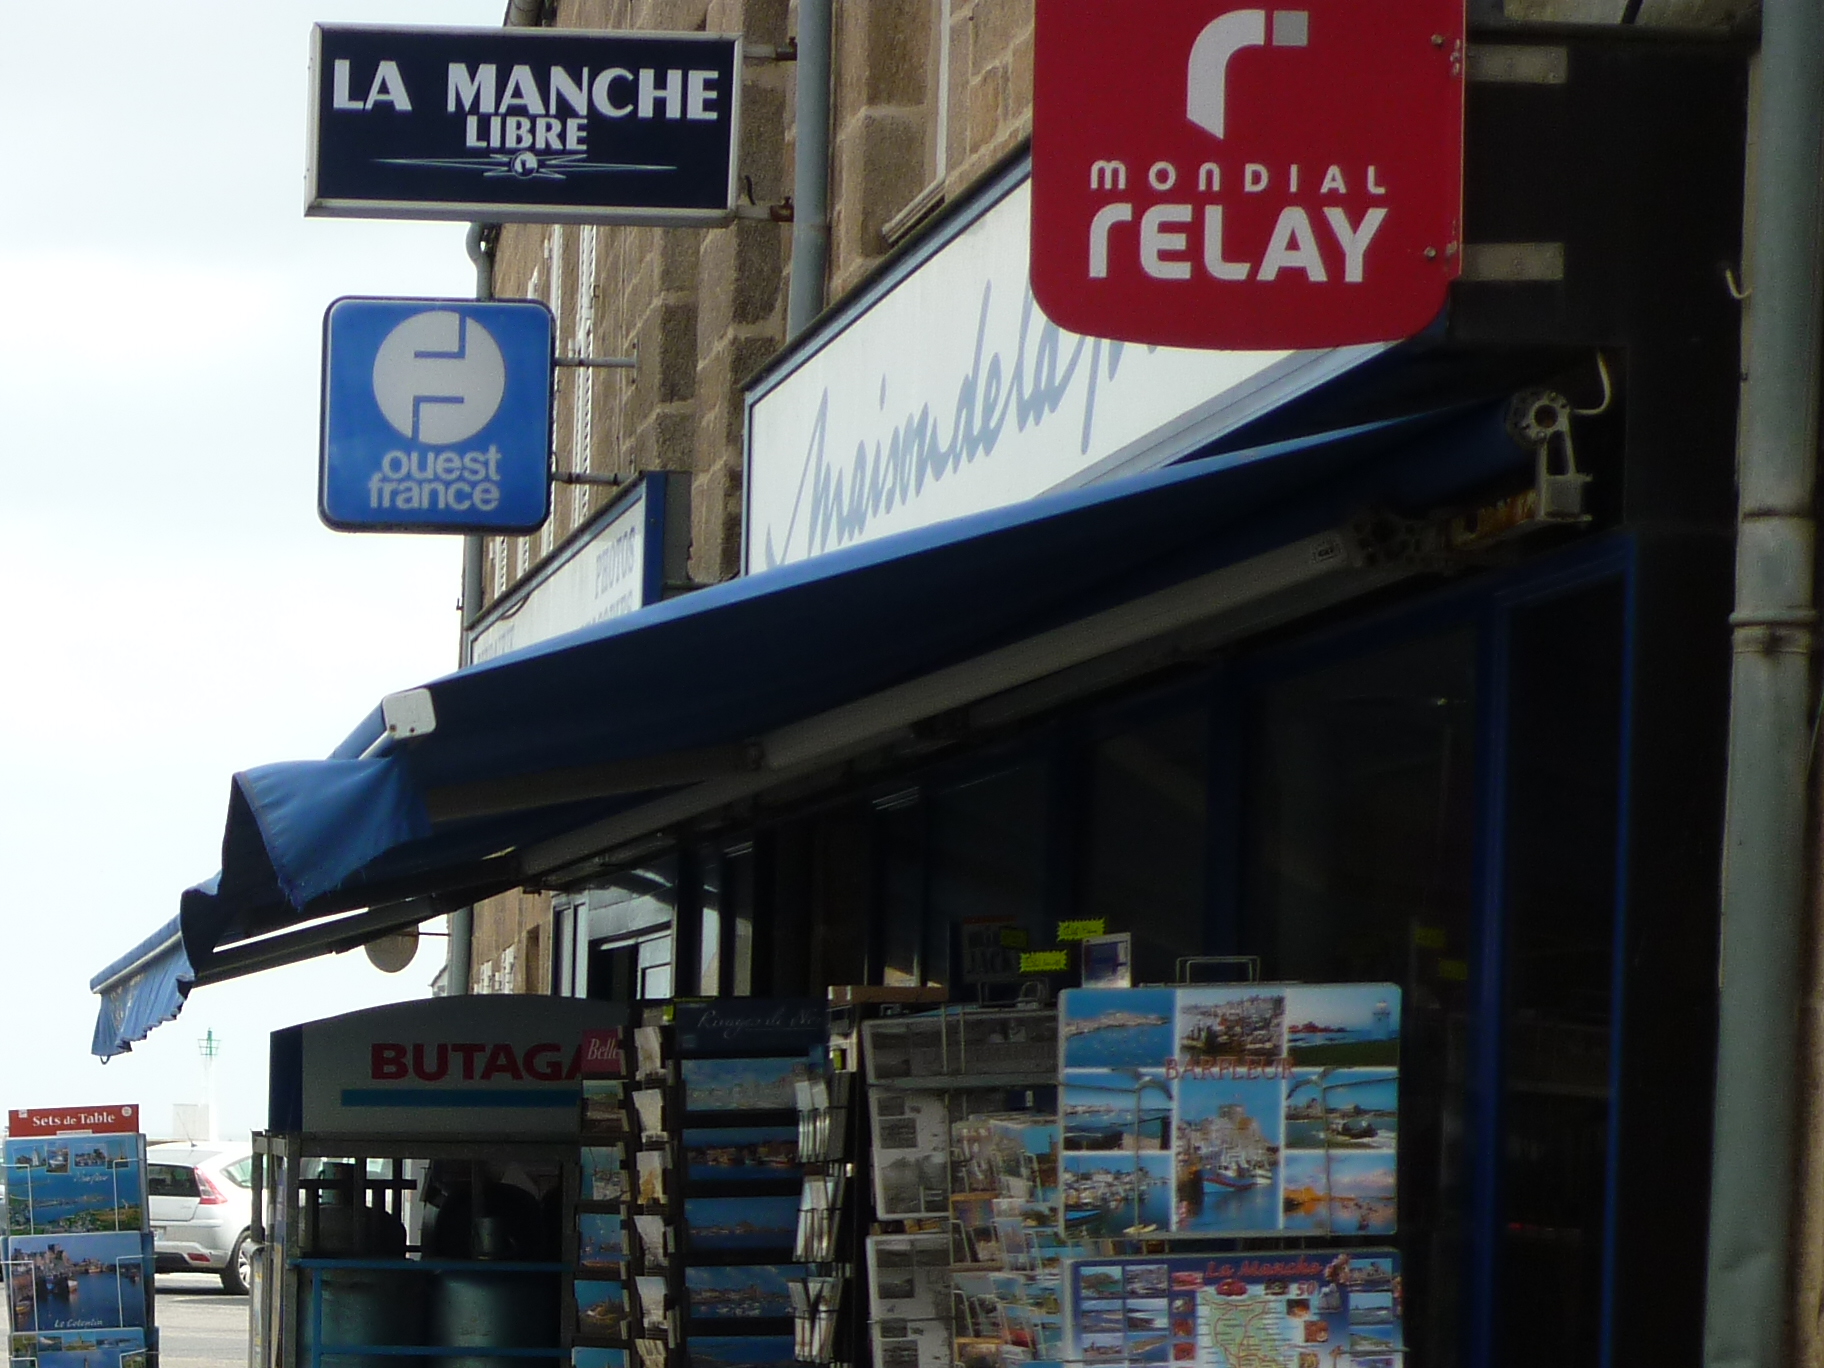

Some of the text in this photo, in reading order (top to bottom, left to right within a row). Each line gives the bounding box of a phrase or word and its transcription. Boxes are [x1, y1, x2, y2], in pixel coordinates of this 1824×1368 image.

[332, 59, 719, 120] LA MANCHE
[465, 116, 588, 151] LIBRE
[949, 279, 1005, 474] de
[382, 445, 503, 481] ouest
[368, 472, 501, 512] france
[1164, 1056, 1297, 1082] BARFLEUR
[32, 1111, 116, 1127] Sets de Table
[54, 1318, 66, 1328] Le
